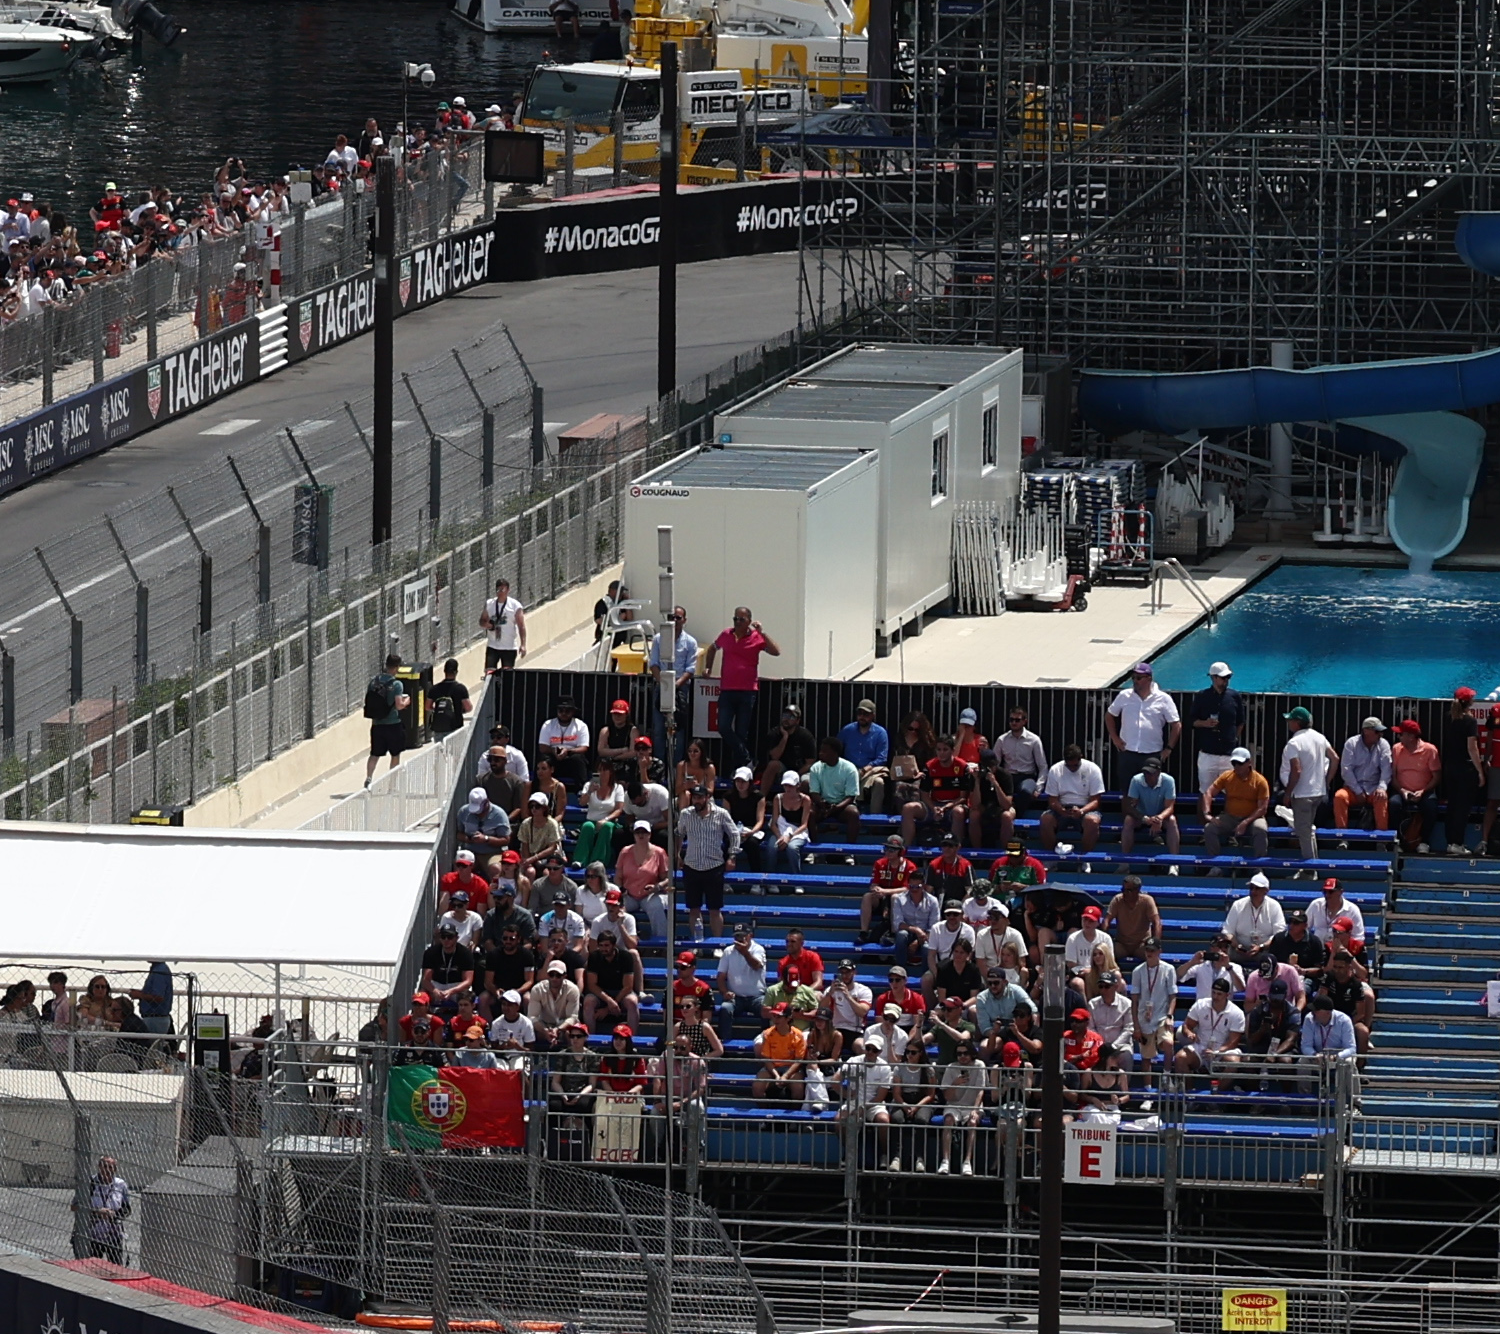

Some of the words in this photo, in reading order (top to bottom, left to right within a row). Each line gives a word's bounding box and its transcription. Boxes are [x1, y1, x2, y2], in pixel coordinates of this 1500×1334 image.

[544, 216, 660, 254] #MonacoG
[316, 277, 375, 348] TAGHeu
[110, 387, 130, 423] MSC
[70, 403, 90, 440] MSC
[34, 420, 54, 457] MSC
[641, 487, 690, 497] COUGNAUD
[700, 685, 720, 697] TRIB
[1071, 1128, 1111, 1141] TRIBUNE
[1080, 1144, 1103, 1179] E
[1234, 1295, 1274, 1306] DANGER
[1258, 1307, 1282, 1317] Tribunes
[1234, 1317, 1274, 1326] INTERDIT
